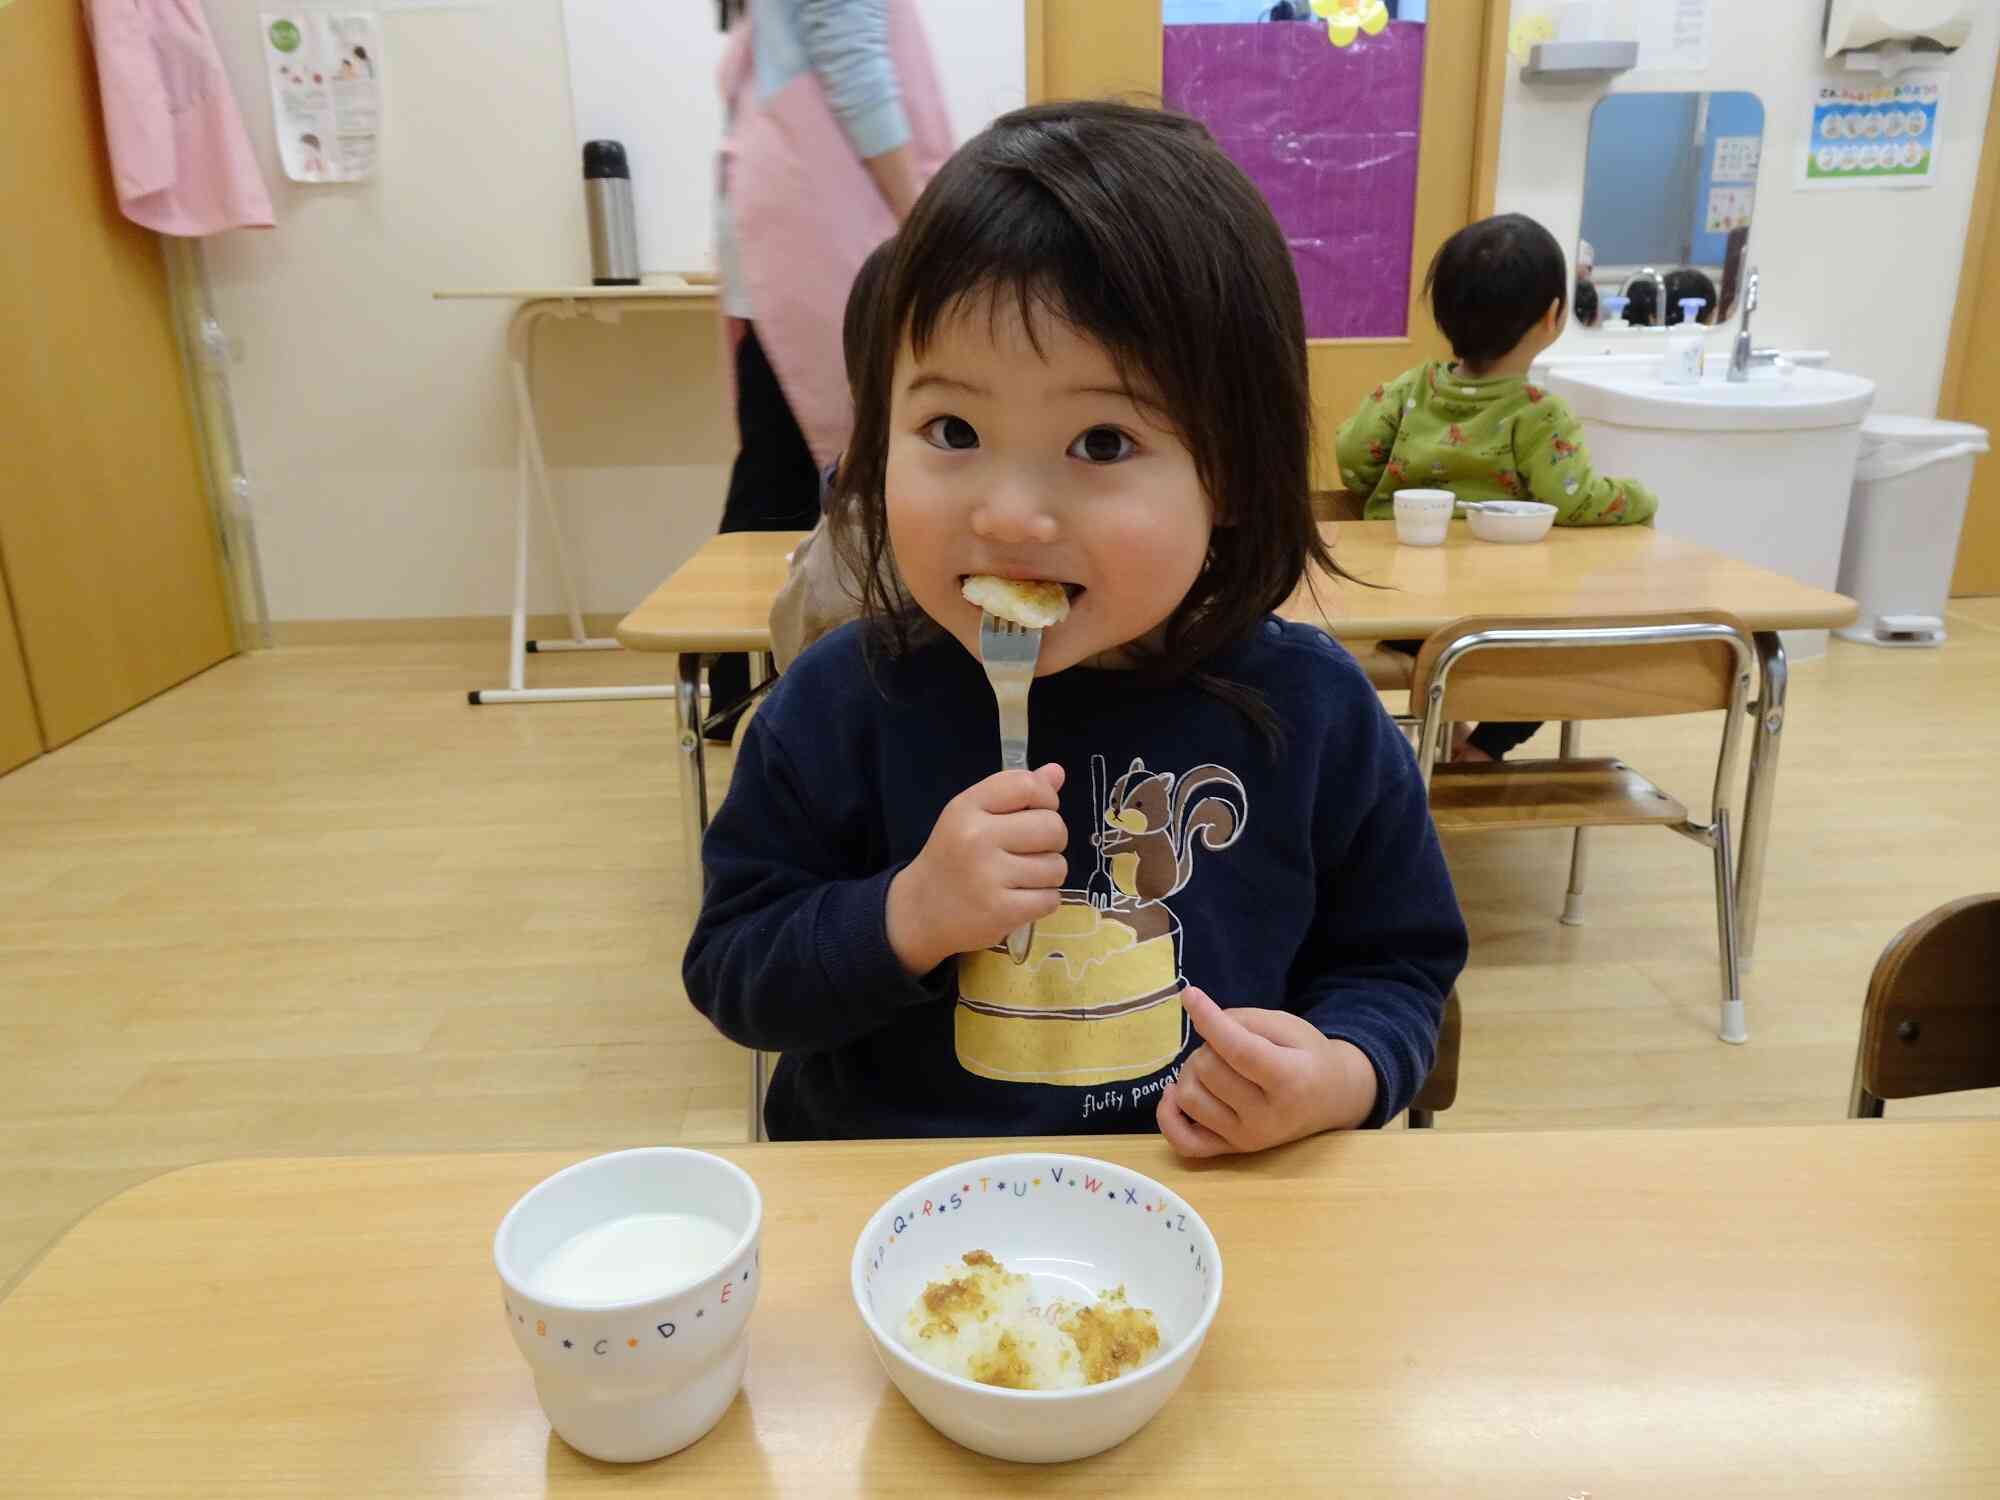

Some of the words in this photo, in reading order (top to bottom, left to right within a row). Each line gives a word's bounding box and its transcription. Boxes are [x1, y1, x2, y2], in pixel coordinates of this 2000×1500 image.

[1082, 1091, 1123, 1118] fluffy
[1132, 1063, 1184, 1108] pancak
[894, 1215, 908, 1234] Q
[921, 1200, 934, 1217] R
[950, 1194, 962, 1210] S
[979, 1177, 989, 1193] T
[1014, 1183, 1026, 1197] U
[1051, 1168, 1063, 1183] V
[1084, 1175, 1103, 1193] W
[1126, 1189, 1138, 1205] X
[1177, 1214, 1187, 1232] Z
[593, 1340, 607, 1356] C
[657, 1323, 676, 1339] D
[720, 1282, 732, 1304] E
